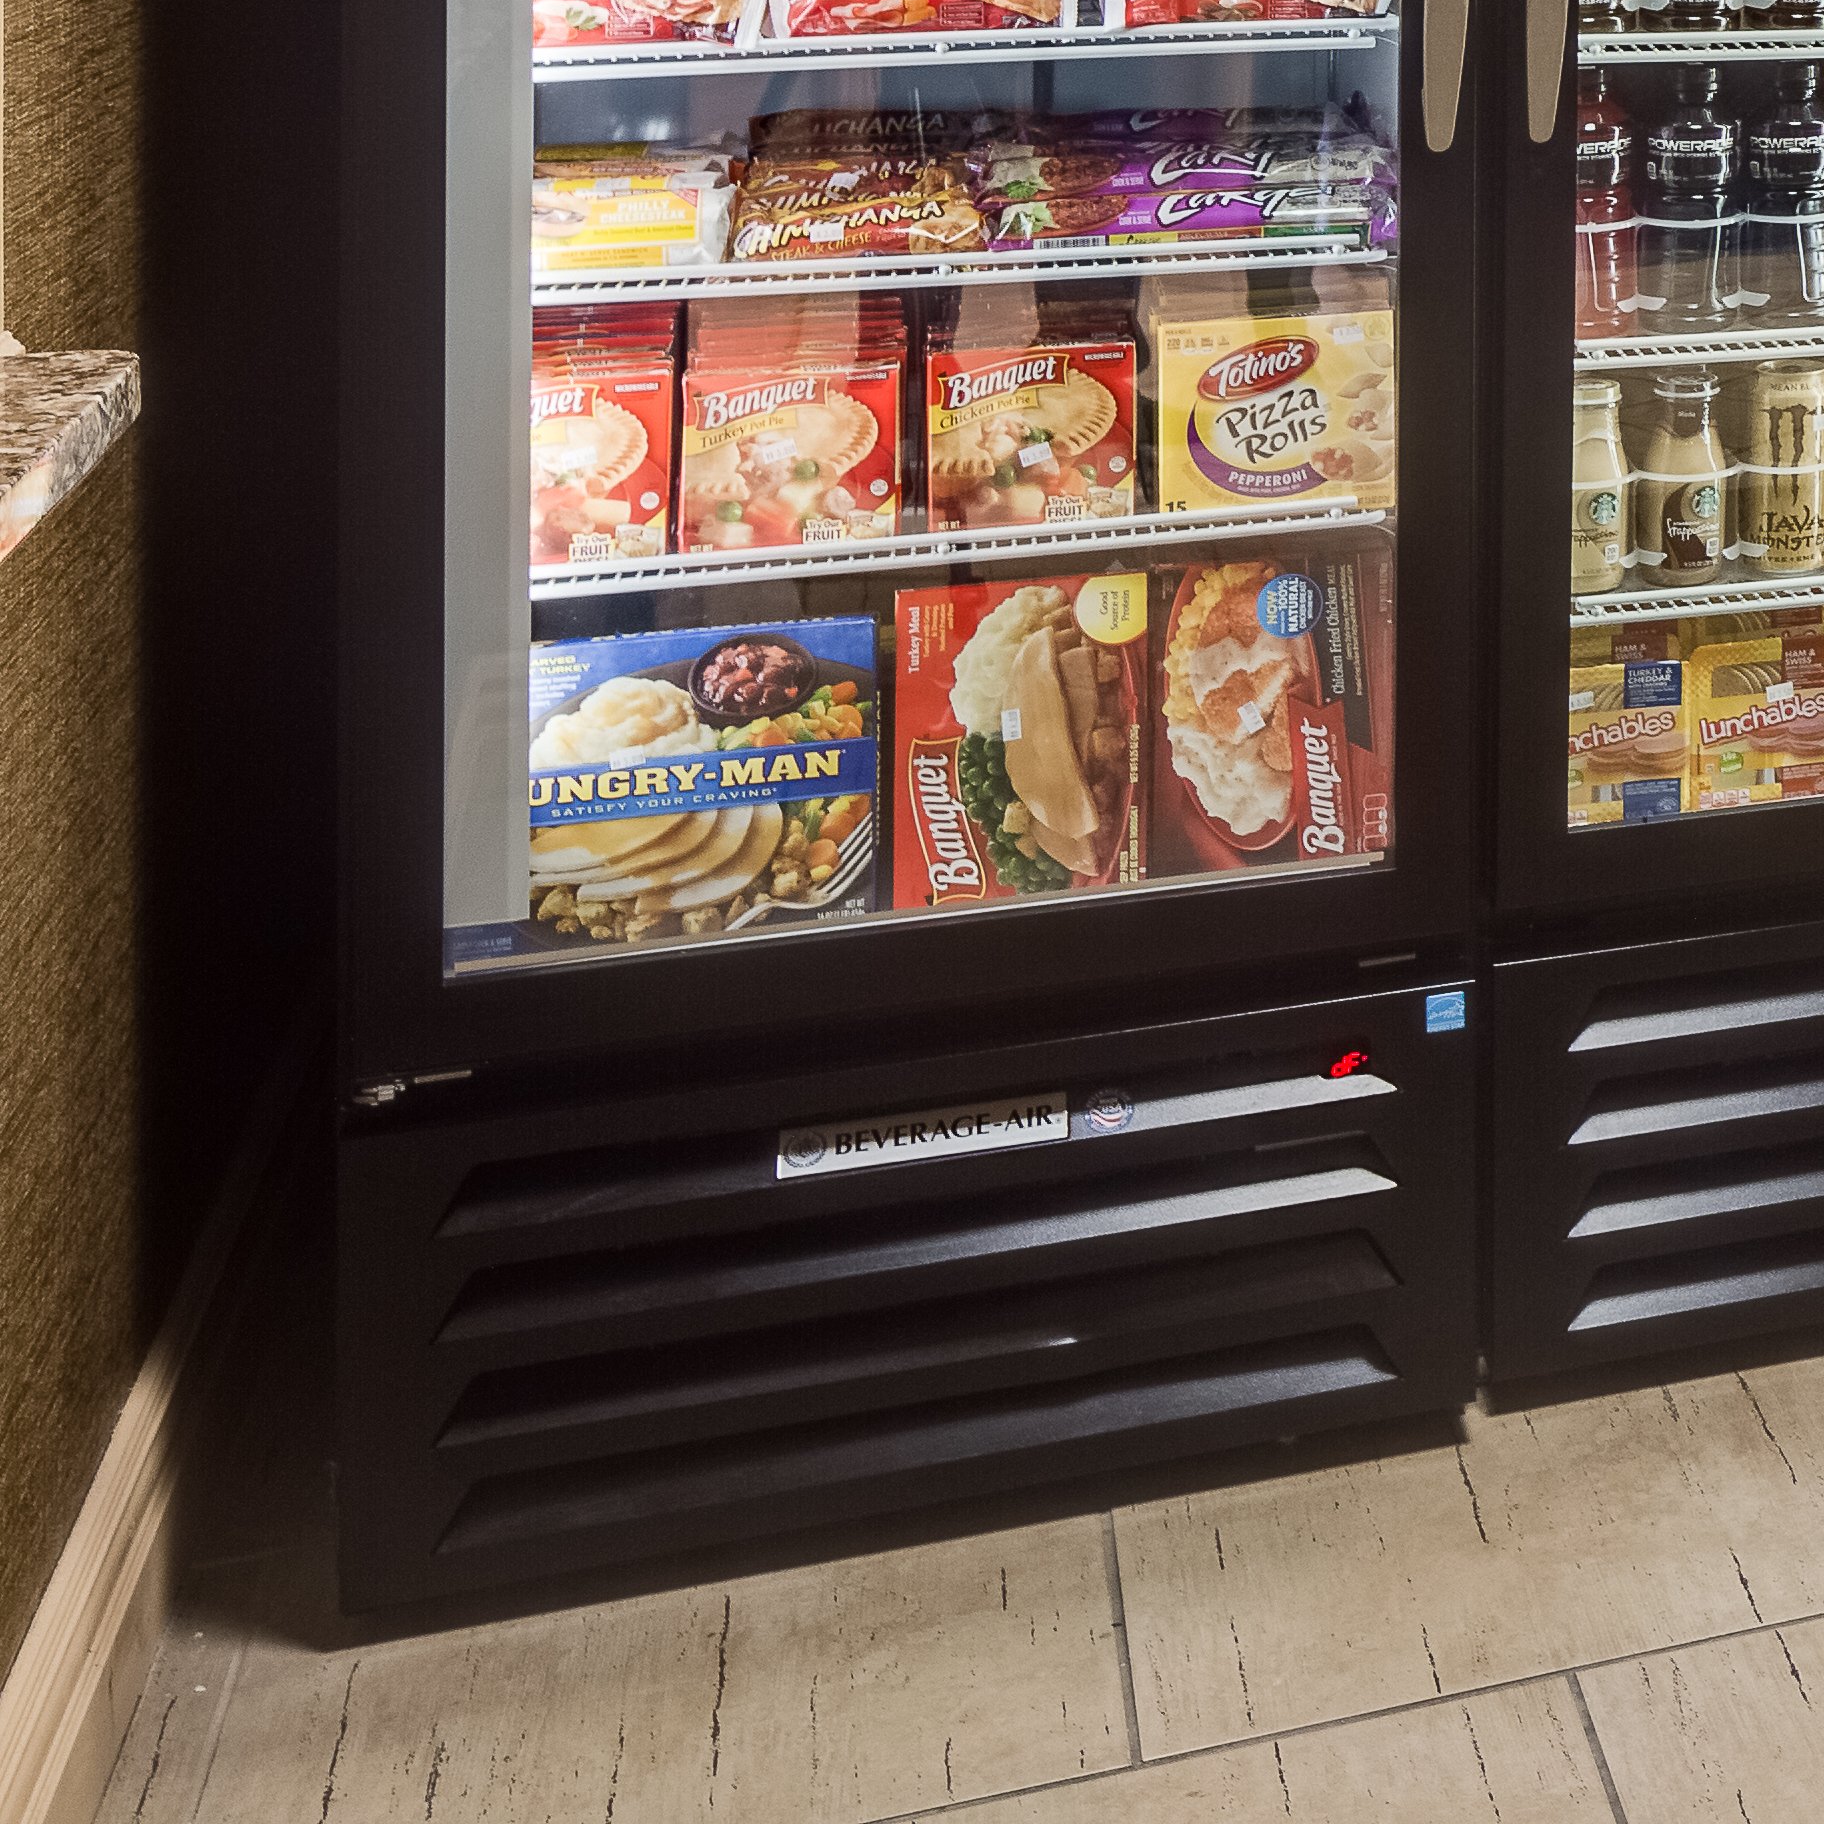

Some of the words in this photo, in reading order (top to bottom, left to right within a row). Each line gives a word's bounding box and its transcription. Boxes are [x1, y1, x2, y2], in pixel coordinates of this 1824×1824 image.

[1648, 137, 1733, 151] POWERADE
[601, 210, 685, 225] CHEESESTEAK
[618, 199, 669, 213] PHILLY
[948, 356, 1057, 408] Banquet
[1210, 341, 1305, 397] Totino's
[703, 377, 816, 430] Banquet
[940, 401, 995, 432] Chicken
[998, 397, 1015, 410] Pot
[1017, 394, 1031, 406] Pie
[1216, 386, 1320, 439] Pizza
[699, 426, 744, 449] Turkey
[749, 419, 769, 431] Pot
[769, 415, 784, 426] Pie
[1235, 413, 1328, 464] Rolls
[1228, 468, 1308, 486] PEPPERONI
[1048, 504, 1083, 519] FRUIT
[1099, 591, 1108, 615] Good
[1110, 590, 1119, 600] of
[1121, 589, 1130, 621] Protein
[1288, 576, 1300, 633] NATURAL
[907, 606, 920, 634] Meal
[1110, 602, 1119, 630] Source
[539, 663, 591, 674] TURKEY
[907, 636, 920, 674] Turkey
[1627, 667, 1662, 678] TURKEY
[1627, 674, 1672, 685] CHEDDAR
[529, 750, 841, 807] UNGRY-MAN
[1303, 719, 1347, 855] Banquet
[551, 801, 627, 818] SATISFY
[636, 796, 684, 809] YOUR
[693, 788, 773, 804] CRAVING
[926, 752, 980, 887] Banquet
[834, 1103, 1053, 1158] BEVERAGE-AIR
